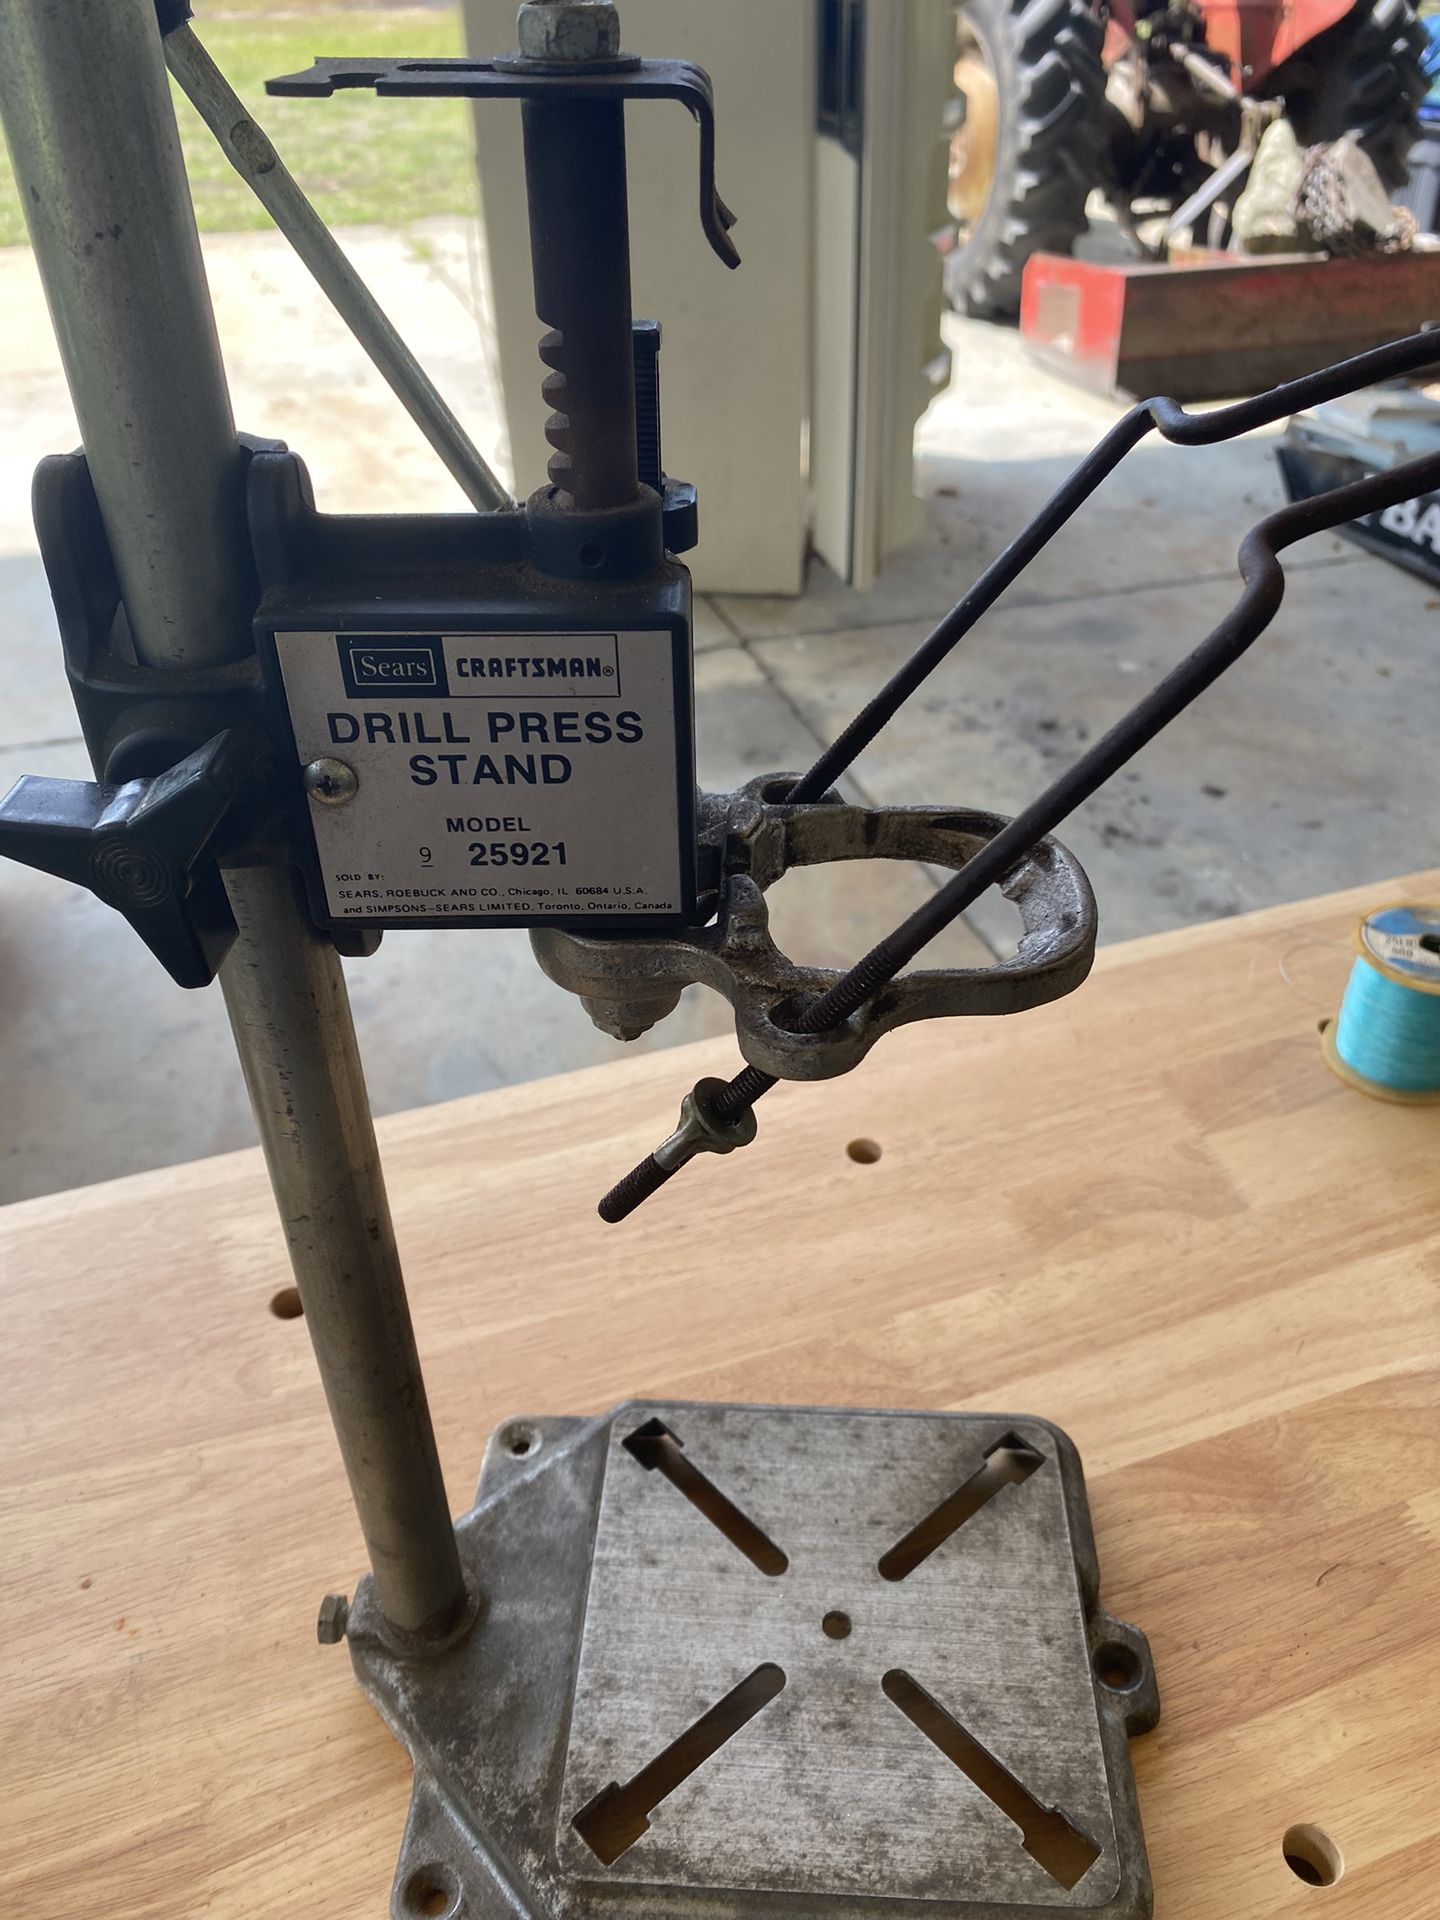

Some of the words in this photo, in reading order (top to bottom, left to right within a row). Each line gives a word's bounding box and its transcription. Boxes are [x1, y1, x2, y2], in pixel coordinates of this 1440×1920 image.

[361, 655, 428, 678] Sears
[326, 711, 471, 744] DRILL
[487, 710, 644, 744] PRESS
[410, 753, 573, 786] STAND
[446, 816, 532, 833] MODEL
[419, 846, 433, 865] 9
[468, 841, 567, 866] 25921
[335, 873, 362, 882] SOLD
[367, 873, 385, 881] BY:
[386, 888, 446, 898] ROEBUCK
[450, 888, 478, 897] AND
[557, 887, 569, 896] IL
[575, 886, 609, 896] 60684
[612, 886, 649, 896] U.S.A.
[343, 905, 363, 914] and
[634, 901, 673, 910] Canada
